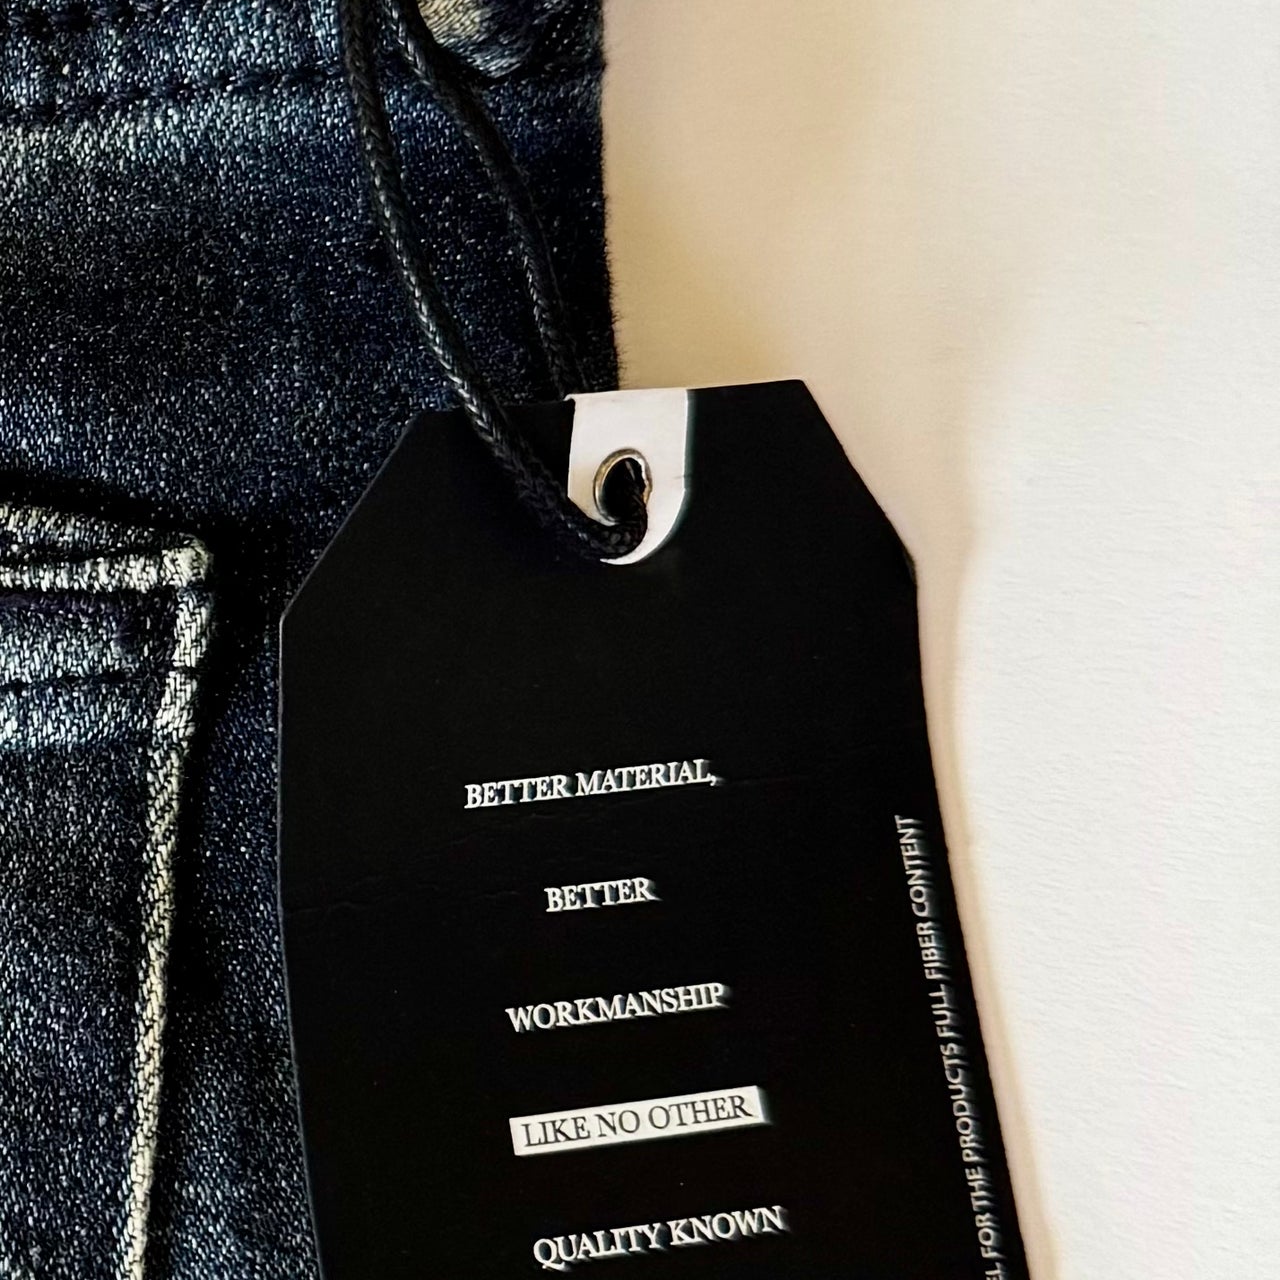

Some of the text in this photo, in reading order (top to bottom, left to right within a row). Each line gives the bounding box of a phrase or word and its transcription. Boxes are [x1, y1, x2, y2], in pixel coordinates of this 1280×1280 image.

[464, 758, 720, 809] BETTER MATERIAL,
[894, 815, 930, 917] CONTENT
[544, 877, 657, 912] BETTER
[916, 921, 946, 980] FIBER
[505, 982, 728, 1033] WORKMANSHIP
[928, 983, 958, 1038] FULL
[521, 1094, 754, 1148] LIKE NO OTHER
[940, 1042, 980, 1163] PRODUCTS
[964, 1166, 991, 1212] THE
[533, 1205, 786, 1271] QUALITY KNOWN
[975, 1212, 1000, 1258] FOR
